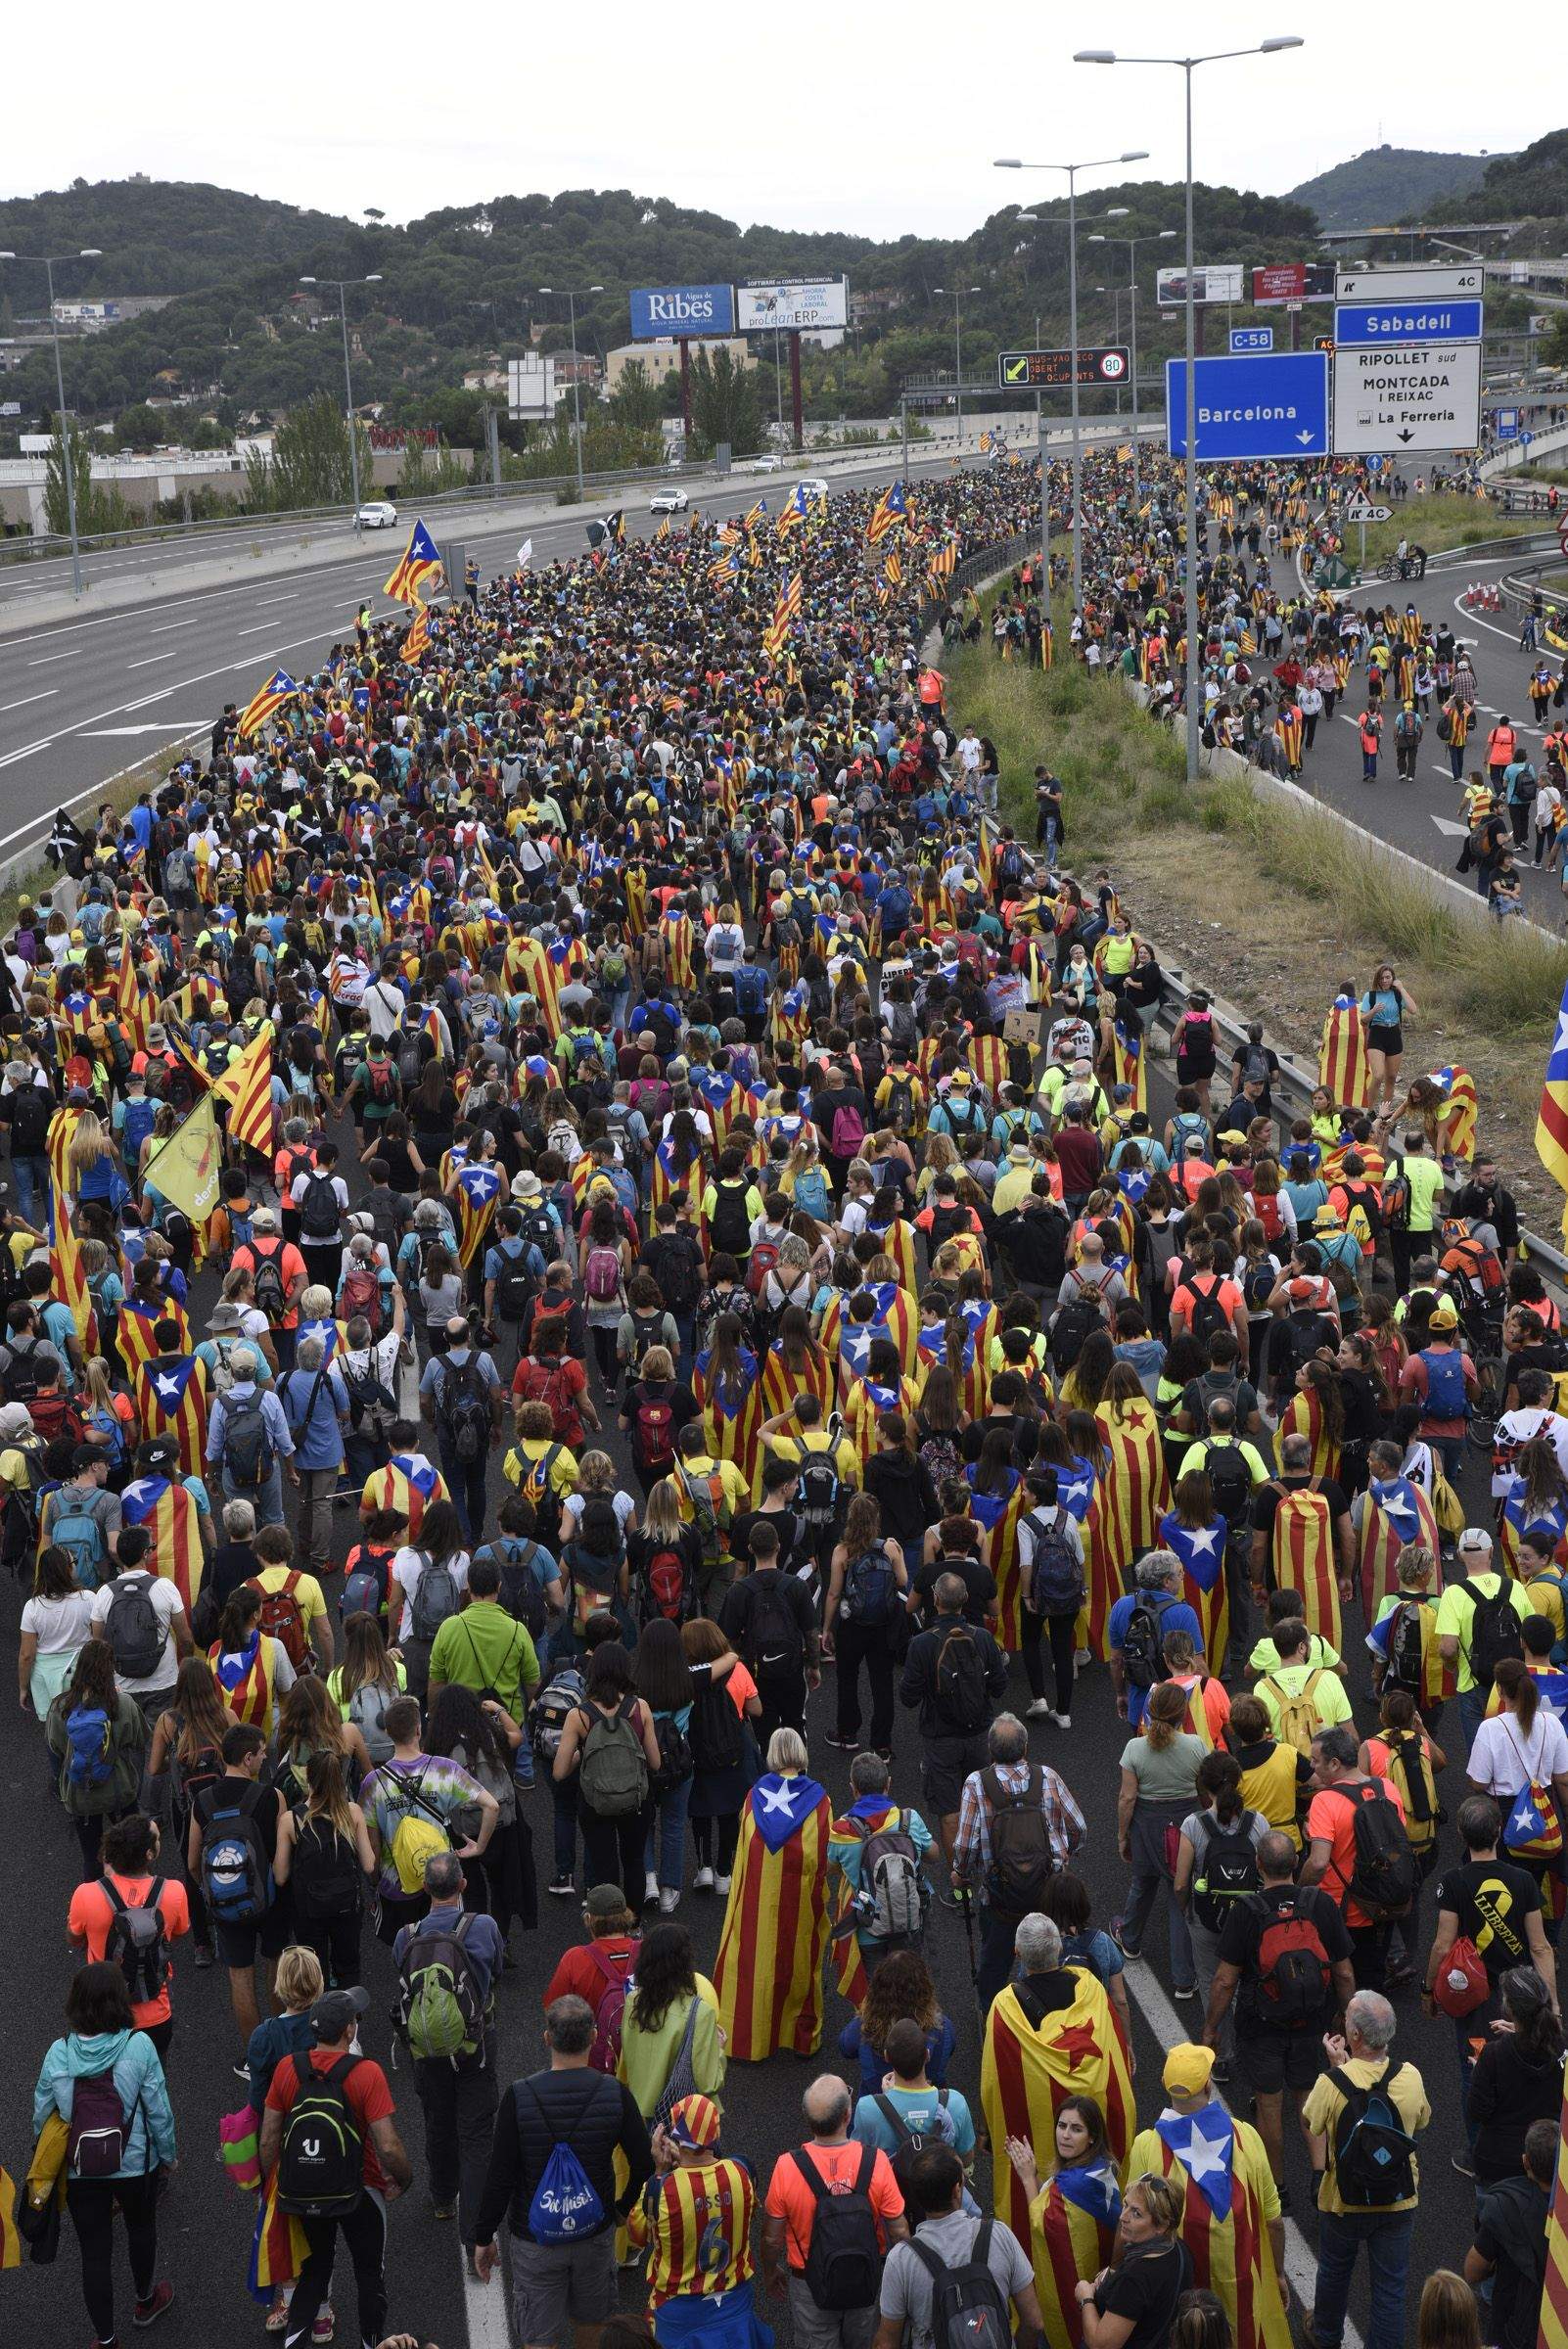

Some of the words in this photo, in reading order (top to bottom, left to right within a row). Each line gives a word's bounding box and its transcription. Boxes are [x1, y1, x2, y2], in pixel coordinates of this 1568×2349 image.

[1458, 276, 1476, 288] 4C
[685, 293, 703, 301] Aigua
[648, 293, 714, 320] Ribes
[1366, 313, 1452, 333] Sabadell
[1234, 334, 1268, 347] C-58
[1105, 359, 1120, 372] 80
[1360, 352, 1430, 367] RIPOLLET
[1438, 352, 1456, 363] sud
[1046, 372, 1094, 382] OCUPNTS
[1363, 375, 1450, 391] MONTCADA
[1379, 392, 1384, 403] I
[1388, 391, 1434, 402] REIXAC
[1198, 406, 1297, 424] Barcelona
[1378, 412, 1395, 424] La
[1401, 410, 1455, 424] Ferreria
[1366, 509, 1385, 519] 4C
[698, 2216, 730, 2275] 6
